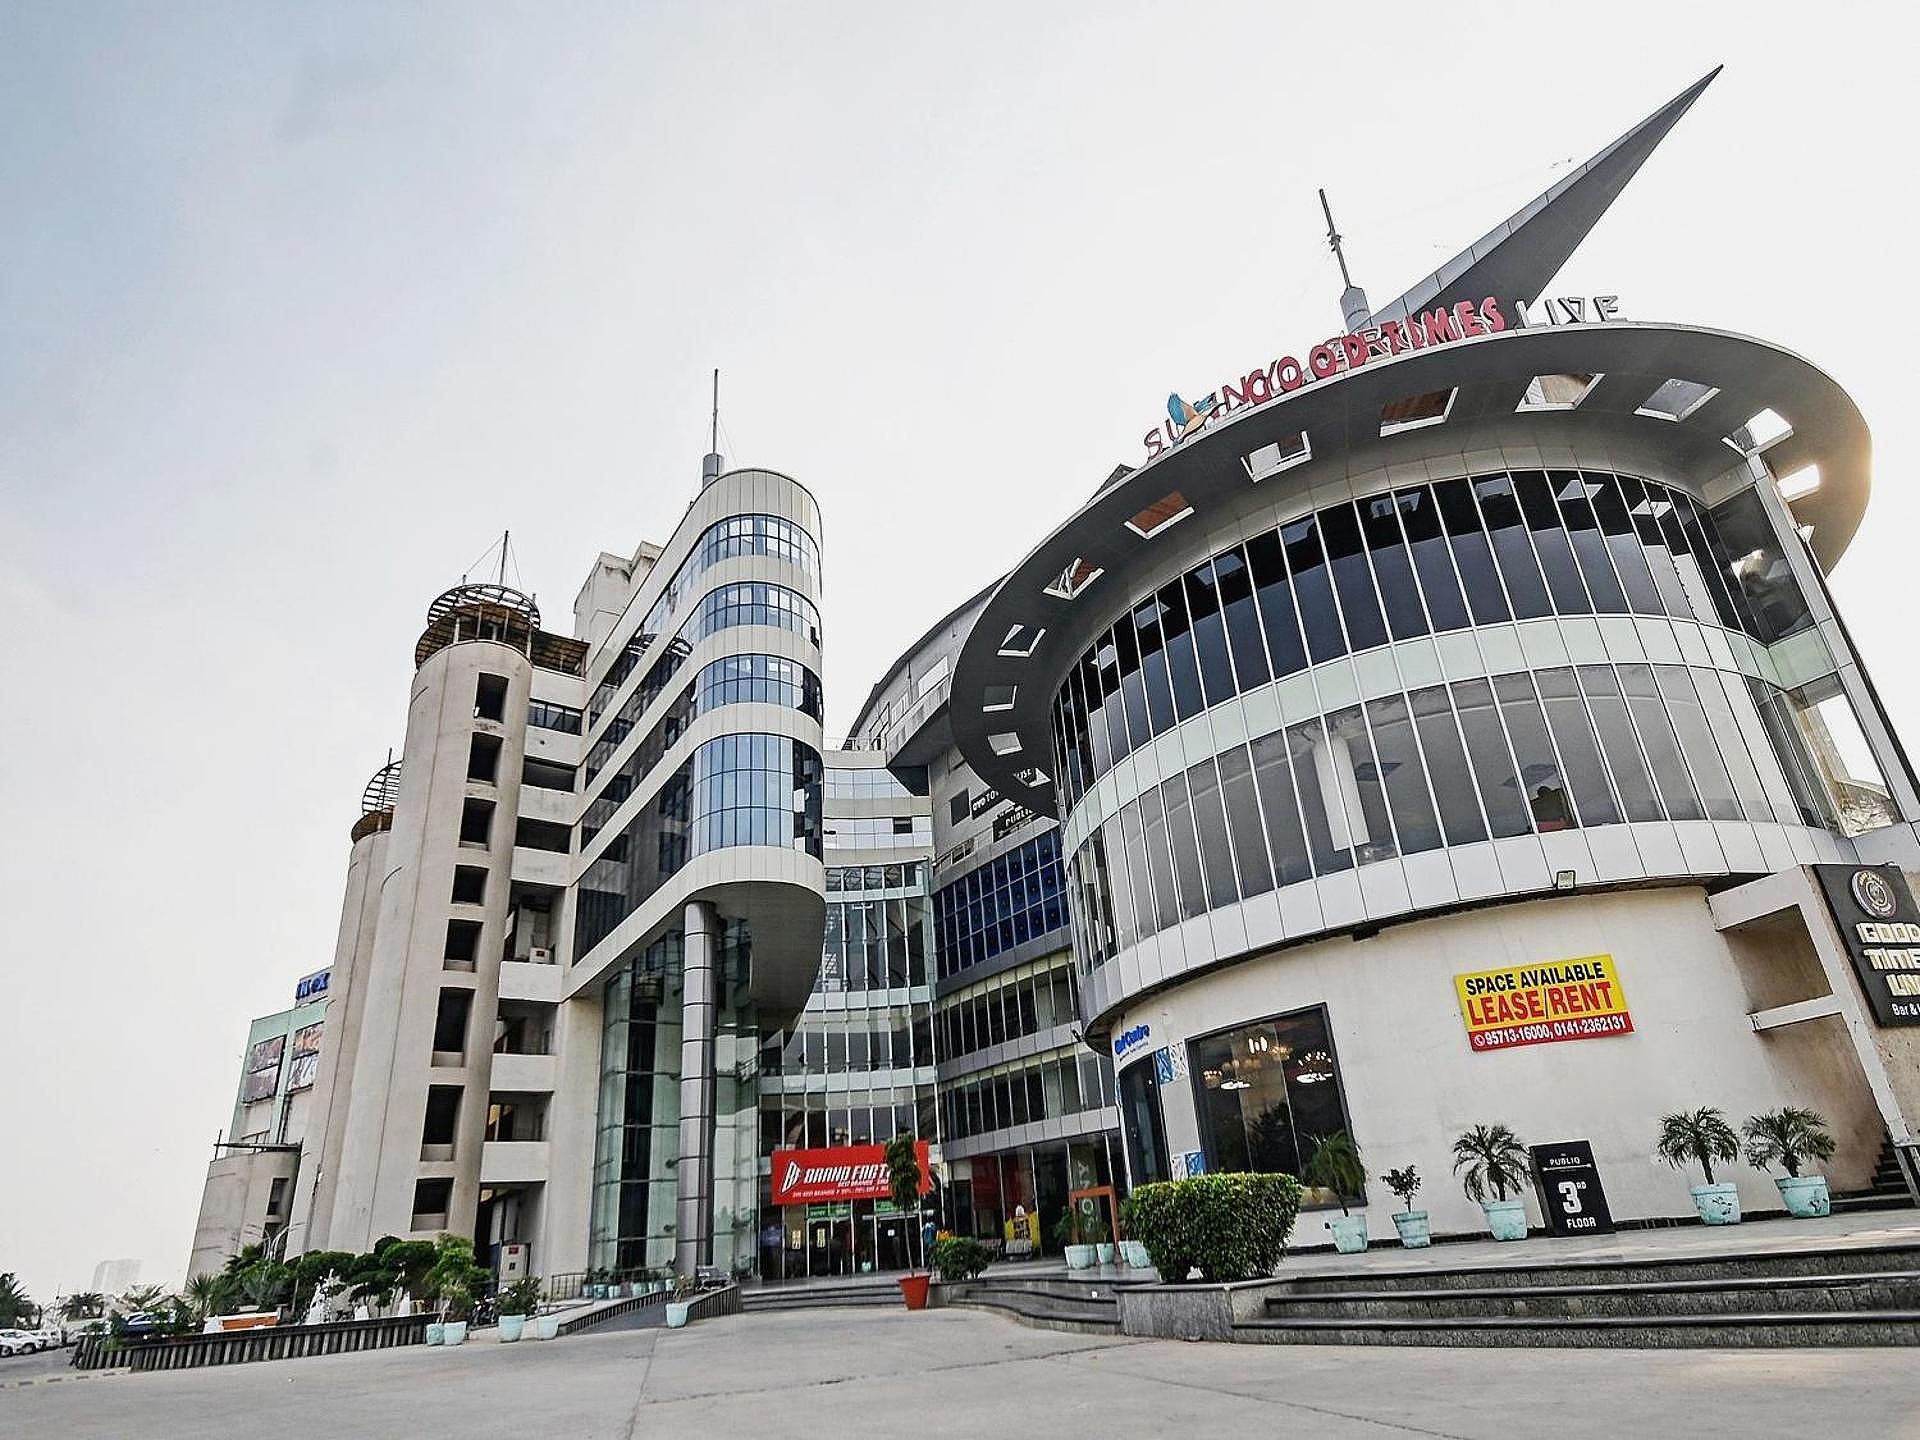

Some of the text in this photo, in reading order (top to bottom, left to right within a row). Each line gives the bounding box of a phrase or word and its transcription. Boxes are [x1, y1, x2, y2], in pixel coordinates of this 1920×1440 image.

[1380, 296, 1505, 356] TIMES
[1516, 296, 1627, 329] LIVE
[1466, 962, 1605, 996] SPACE AVAILABLE
[1466, 980, 1614, 1026] LEASE/RENT
[1892, 1003, 1909, 1016] Bar
[1555, 1015, 1627, 1037] 0141-2362131
[1566, 1216, 1597, 1229] FLOOR
